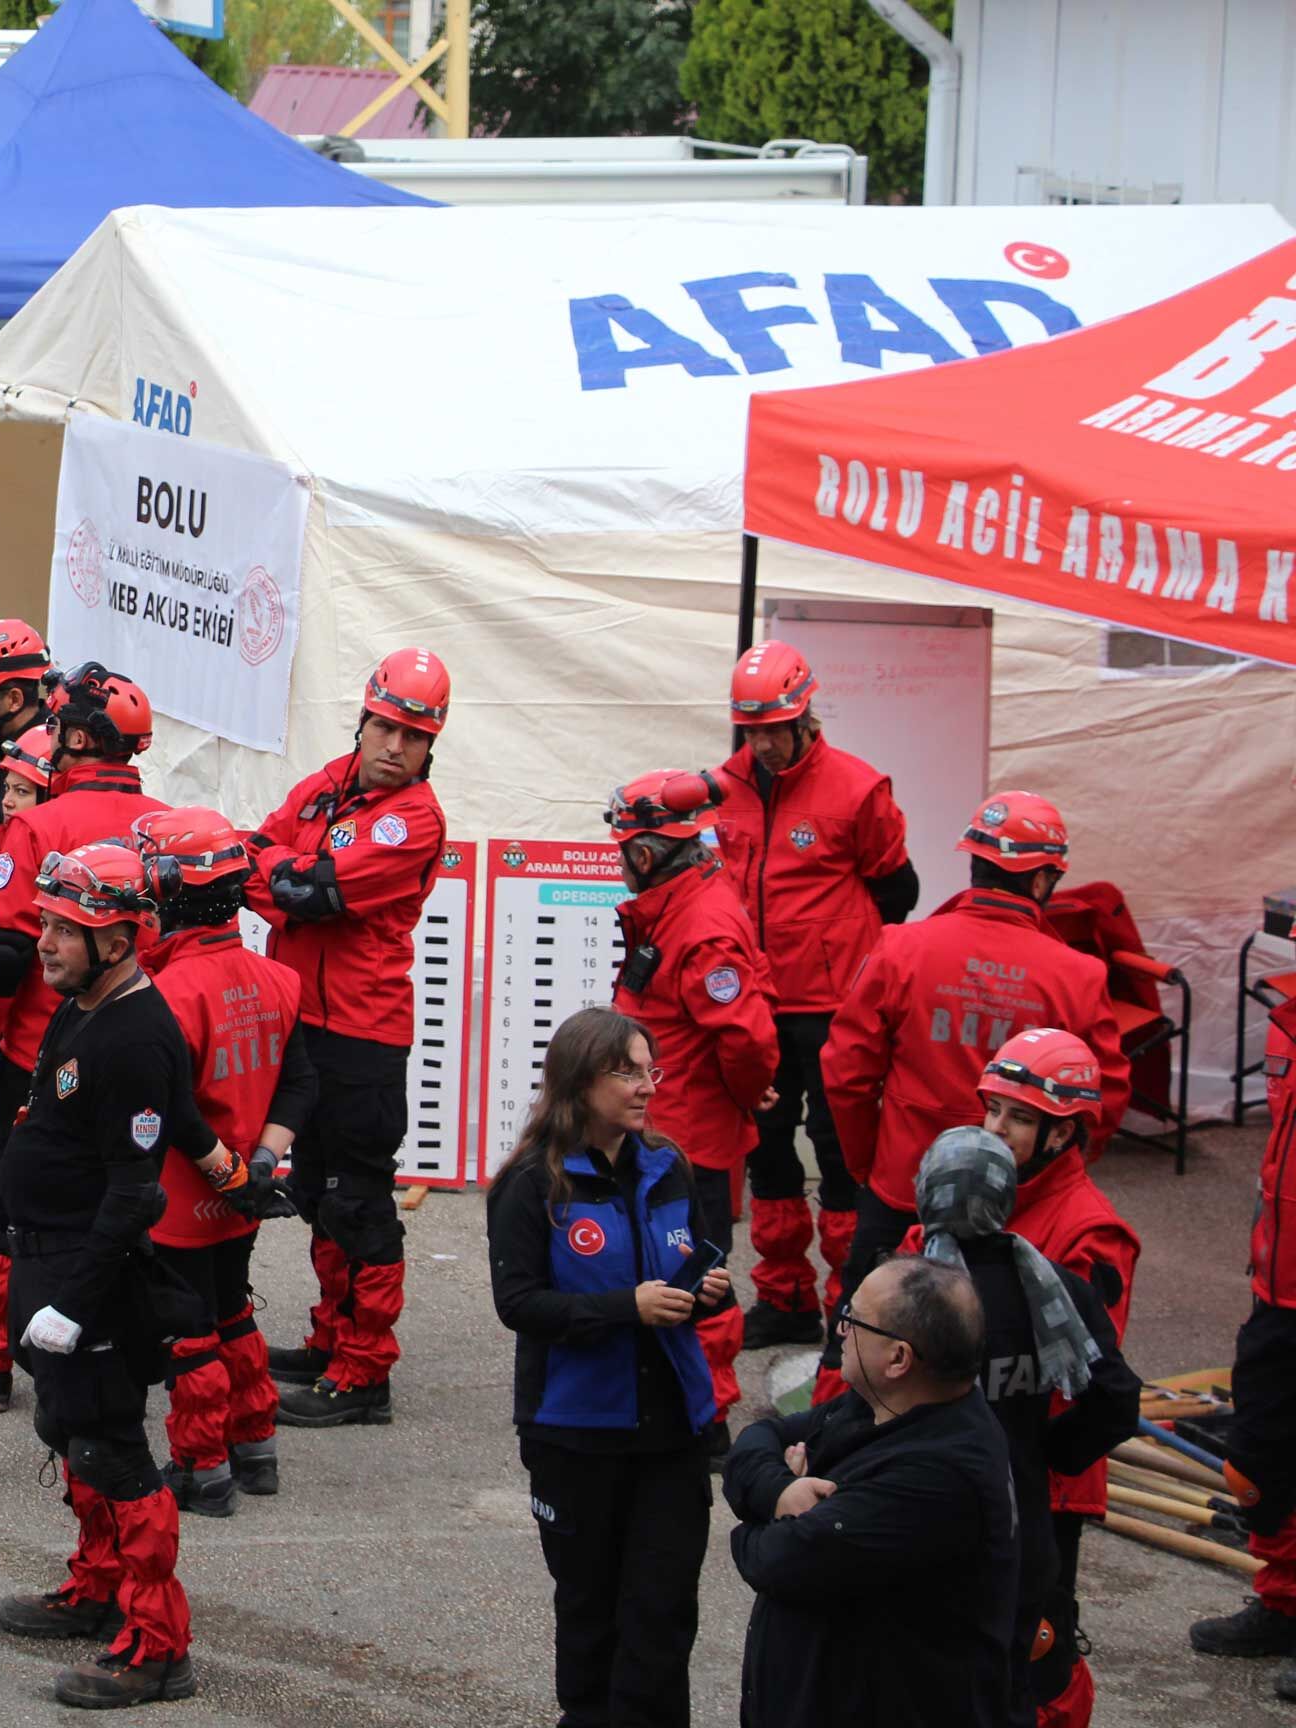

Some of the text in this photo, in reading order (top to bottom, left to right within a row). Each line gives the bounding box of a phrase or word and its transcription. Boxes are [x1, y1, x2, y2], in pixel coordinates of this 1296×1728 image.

[569, 271, 1086, 391] AFAD
[133, 377, 193, 437] AFAD
[1079, 394, 1271, 458] ARAMA
[136, 475, 207, 538] BOLU
[814, 453, 924, 539] BOLU
[937, 474, 1043, 566] ACİL
[1060, 506, 1239, 614] ARAMA
[140, 549, 170, 577] EĞİTİM
[143, 590, 189, 633] AKUB
[192, 602, 234, 647] EKİBİ
[562, 850, 622, 863] BOLU AC
[525, 862, 623, 876] ARAMA KURTAR
[506, 914, 512, 923] 1
[584, 916, 598, 926] 14
[506, 934, 512, 944] 2
[584, 938, 597, 947] 15
[506, 955, 512, 964] 3
[583, 958, 596, 968] 16
[966, 957, 1026, 981] BOLU
[504, 976, 512, 986] 4
[582, 979, 596, 988] 17
[504, 997, 511, 1006] 5
[504, 1017, 510, 1027] 6
[930, 1007, 1037, 1051] BAK
[502, 1038, 509, 1048] 7
[502, 1058, 508, 1068] 8
[501, 1080, 508, 1090] 9
[501, 1100, 514, 1110] 10
[500, 1121, 512, 1130] 11
[500, 1142, 513, 1152] 12
[667, 1227, 690, 1247] AFA
[987, 1354, 1040, 1401] FA
